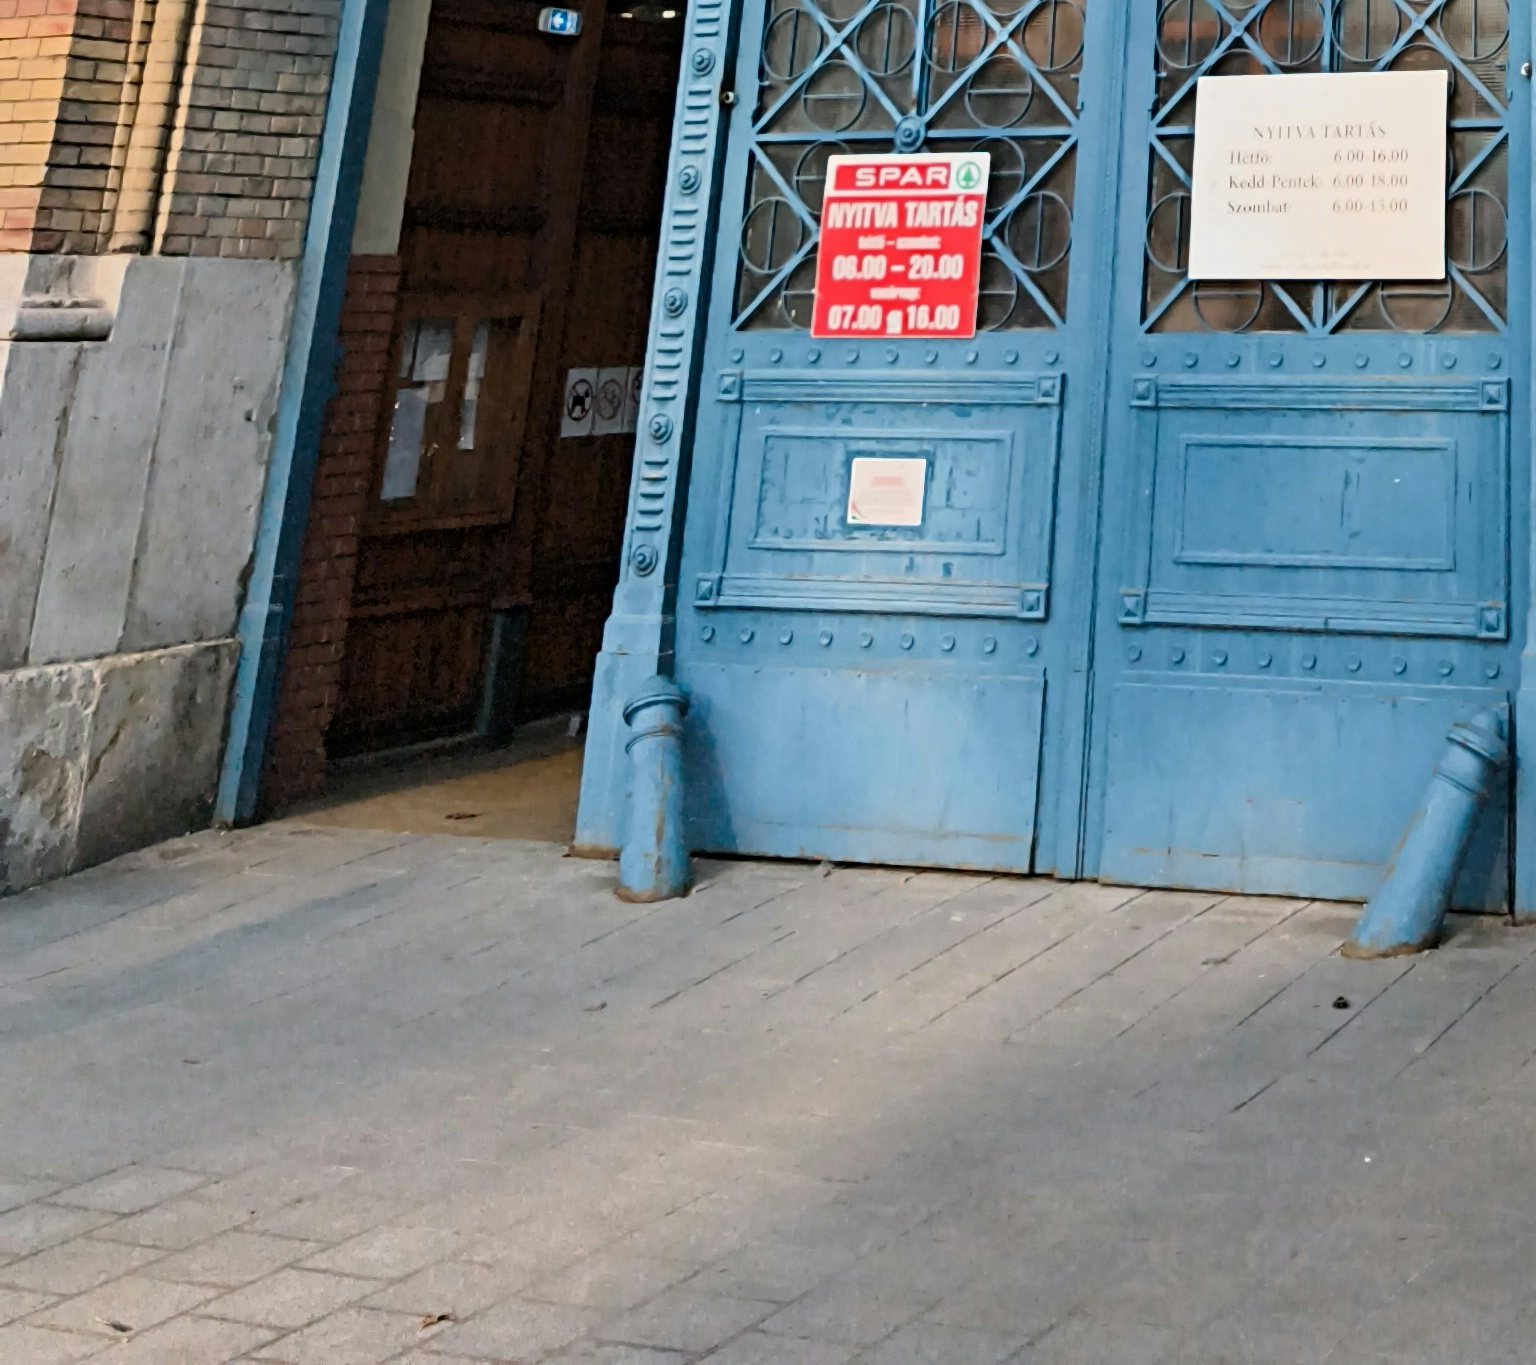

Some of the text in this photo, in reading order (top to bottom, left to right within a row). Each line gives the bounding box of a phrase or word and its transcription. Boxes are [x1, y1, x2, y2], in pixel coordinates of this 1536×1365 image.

[1253, 121, 1386, 140] NYITVA TARTÁS
[855, 166, 949, 187] SPAR
[827, 195, 979, 229] NYITVA TARTÁS
[907, 254, 963, 280] 20.00
[828, 305, 960, 330] 07.00 16.00
